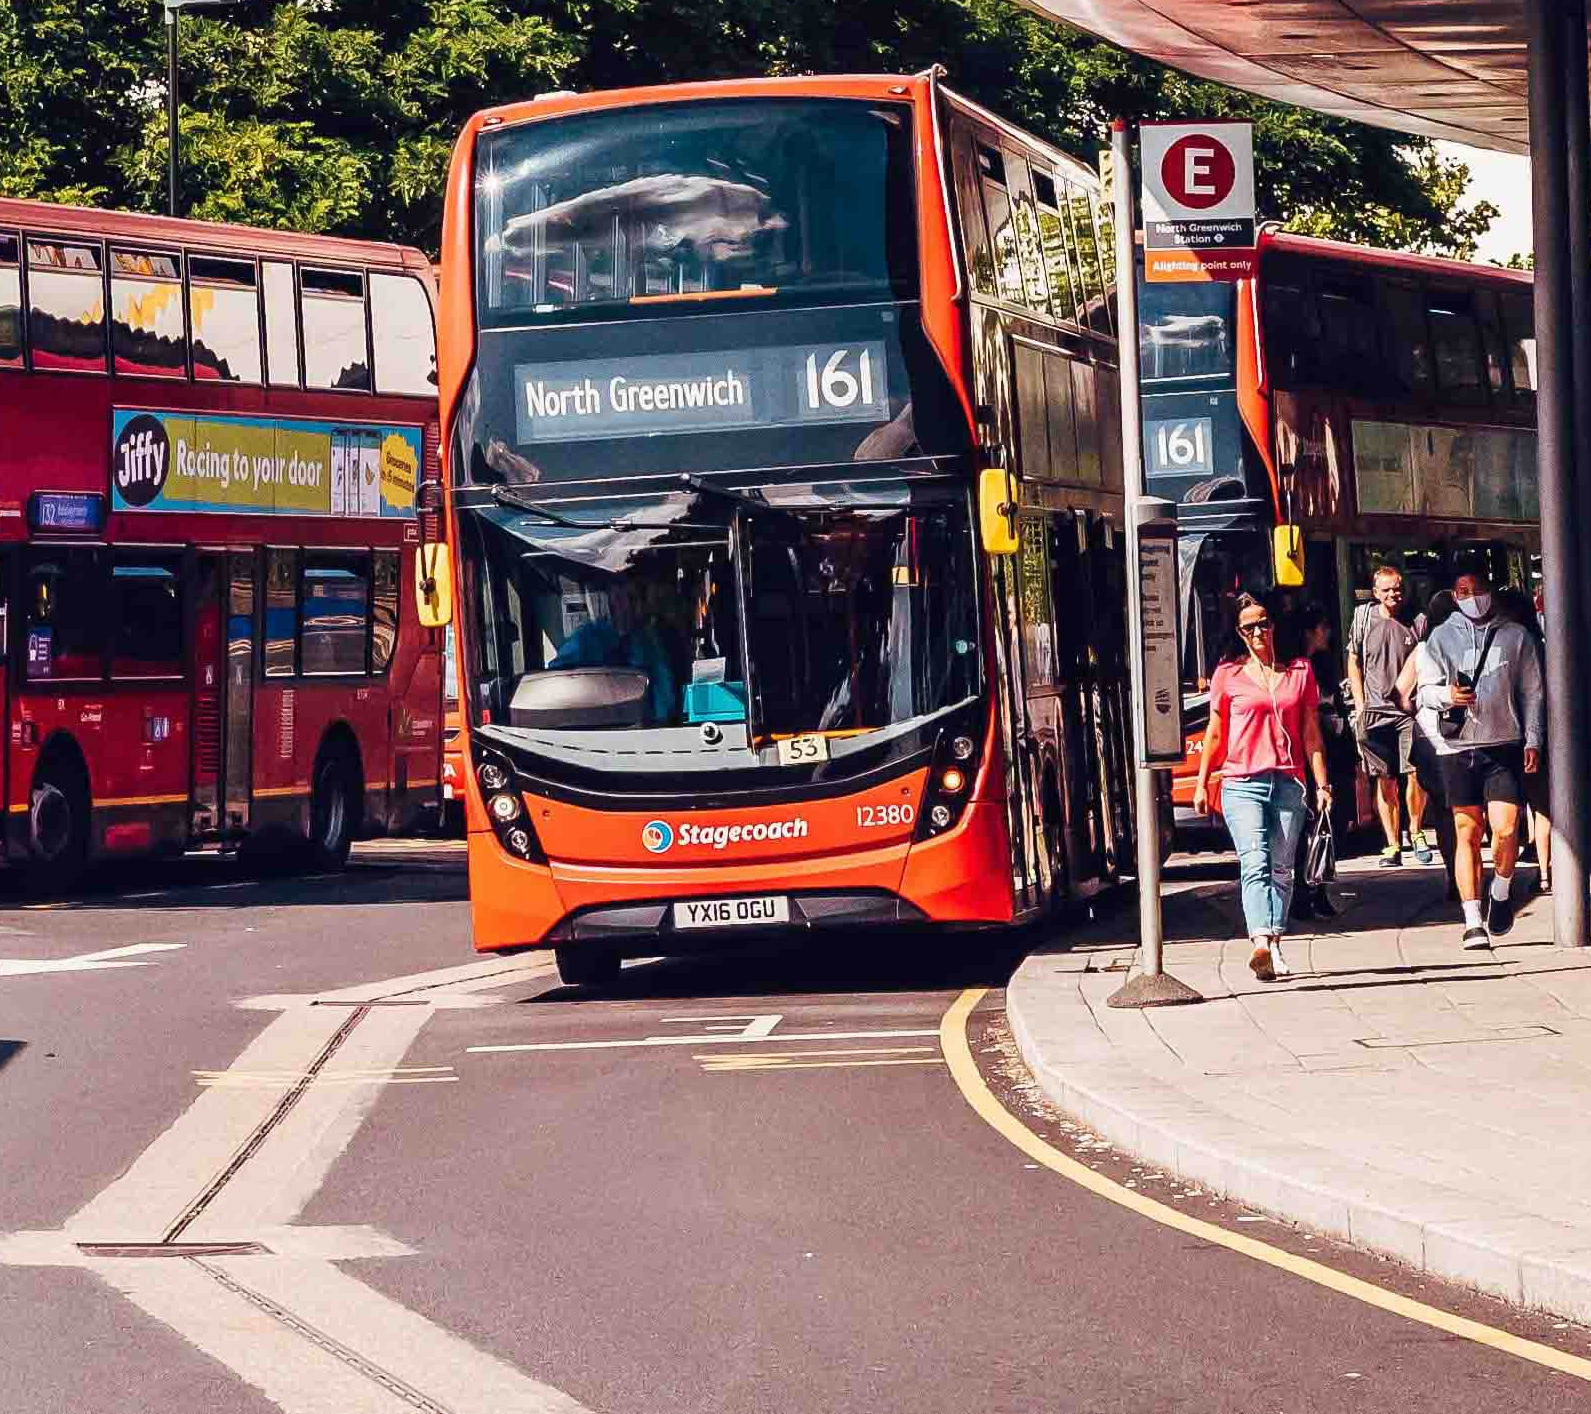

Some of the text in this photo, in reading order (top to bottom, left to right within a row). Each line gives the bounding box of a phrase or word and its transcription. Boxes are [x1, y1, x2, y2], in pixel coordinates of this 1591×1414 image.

[1184, 147, 1216, 195] E
[1156, 221, 1243, 234] North Greenwich
[1174, 234, 1211, 245] Station
[1201, 260, 1228, 272] point
[1230, 259, 1252, 271] only
[525, 348, 873, 418] North Greenwich 161
[1158, 422, 1205, 466] 161
[118, 430, 165, 487] Jiffy
[176, 436, 324, 492] Racing to your door
[790, 738, 818, 759] 53
[856, 804, 914, 828] 12380
[677, 817, 808, 850] Stagecoach
[687, 900, 775, 923] YX16 OGU
